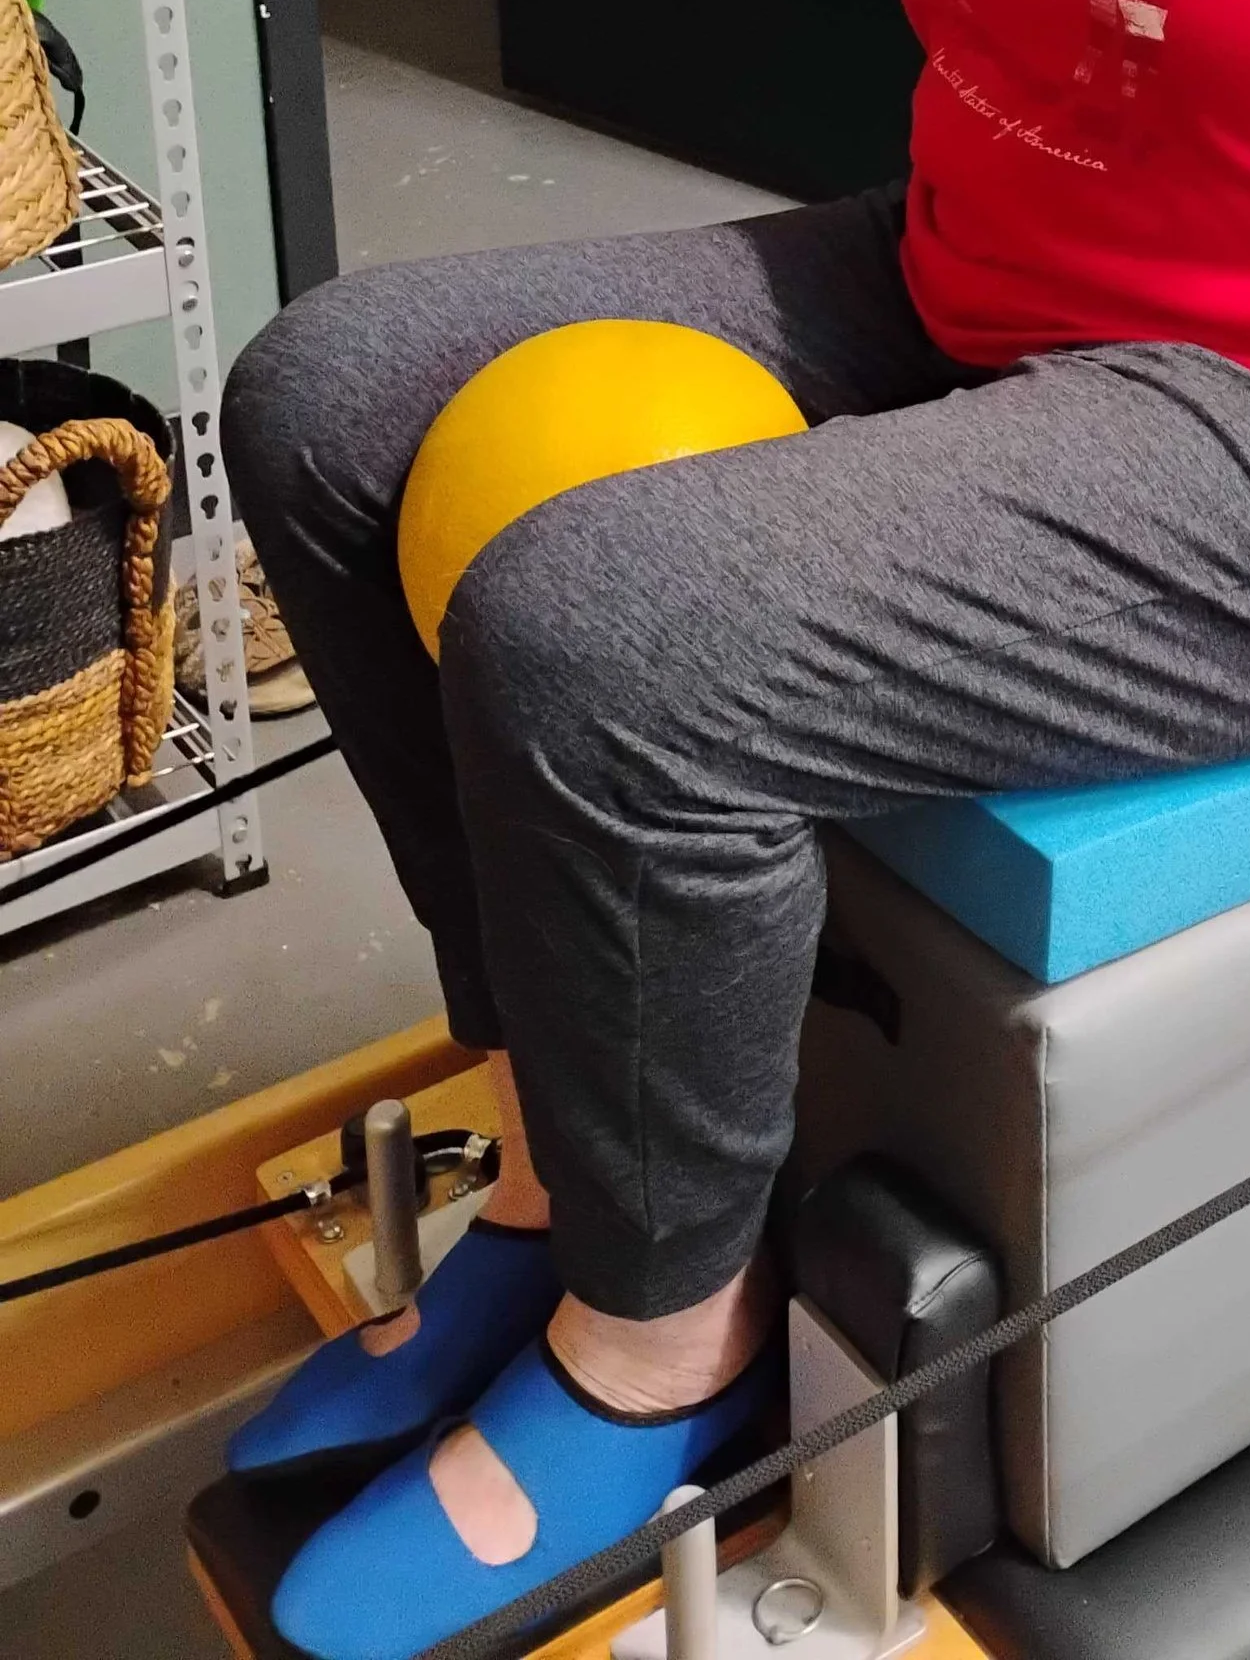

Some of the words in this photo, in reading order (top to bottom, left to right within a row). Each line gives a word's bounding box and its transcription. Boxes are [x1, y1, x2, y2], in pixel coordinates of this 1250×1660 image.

[931, 47, 964, 90] United
[958, 85, 1001, 118] States
[992, 117, 1022, 140] of
[1016, 125, 1107, 171] America
